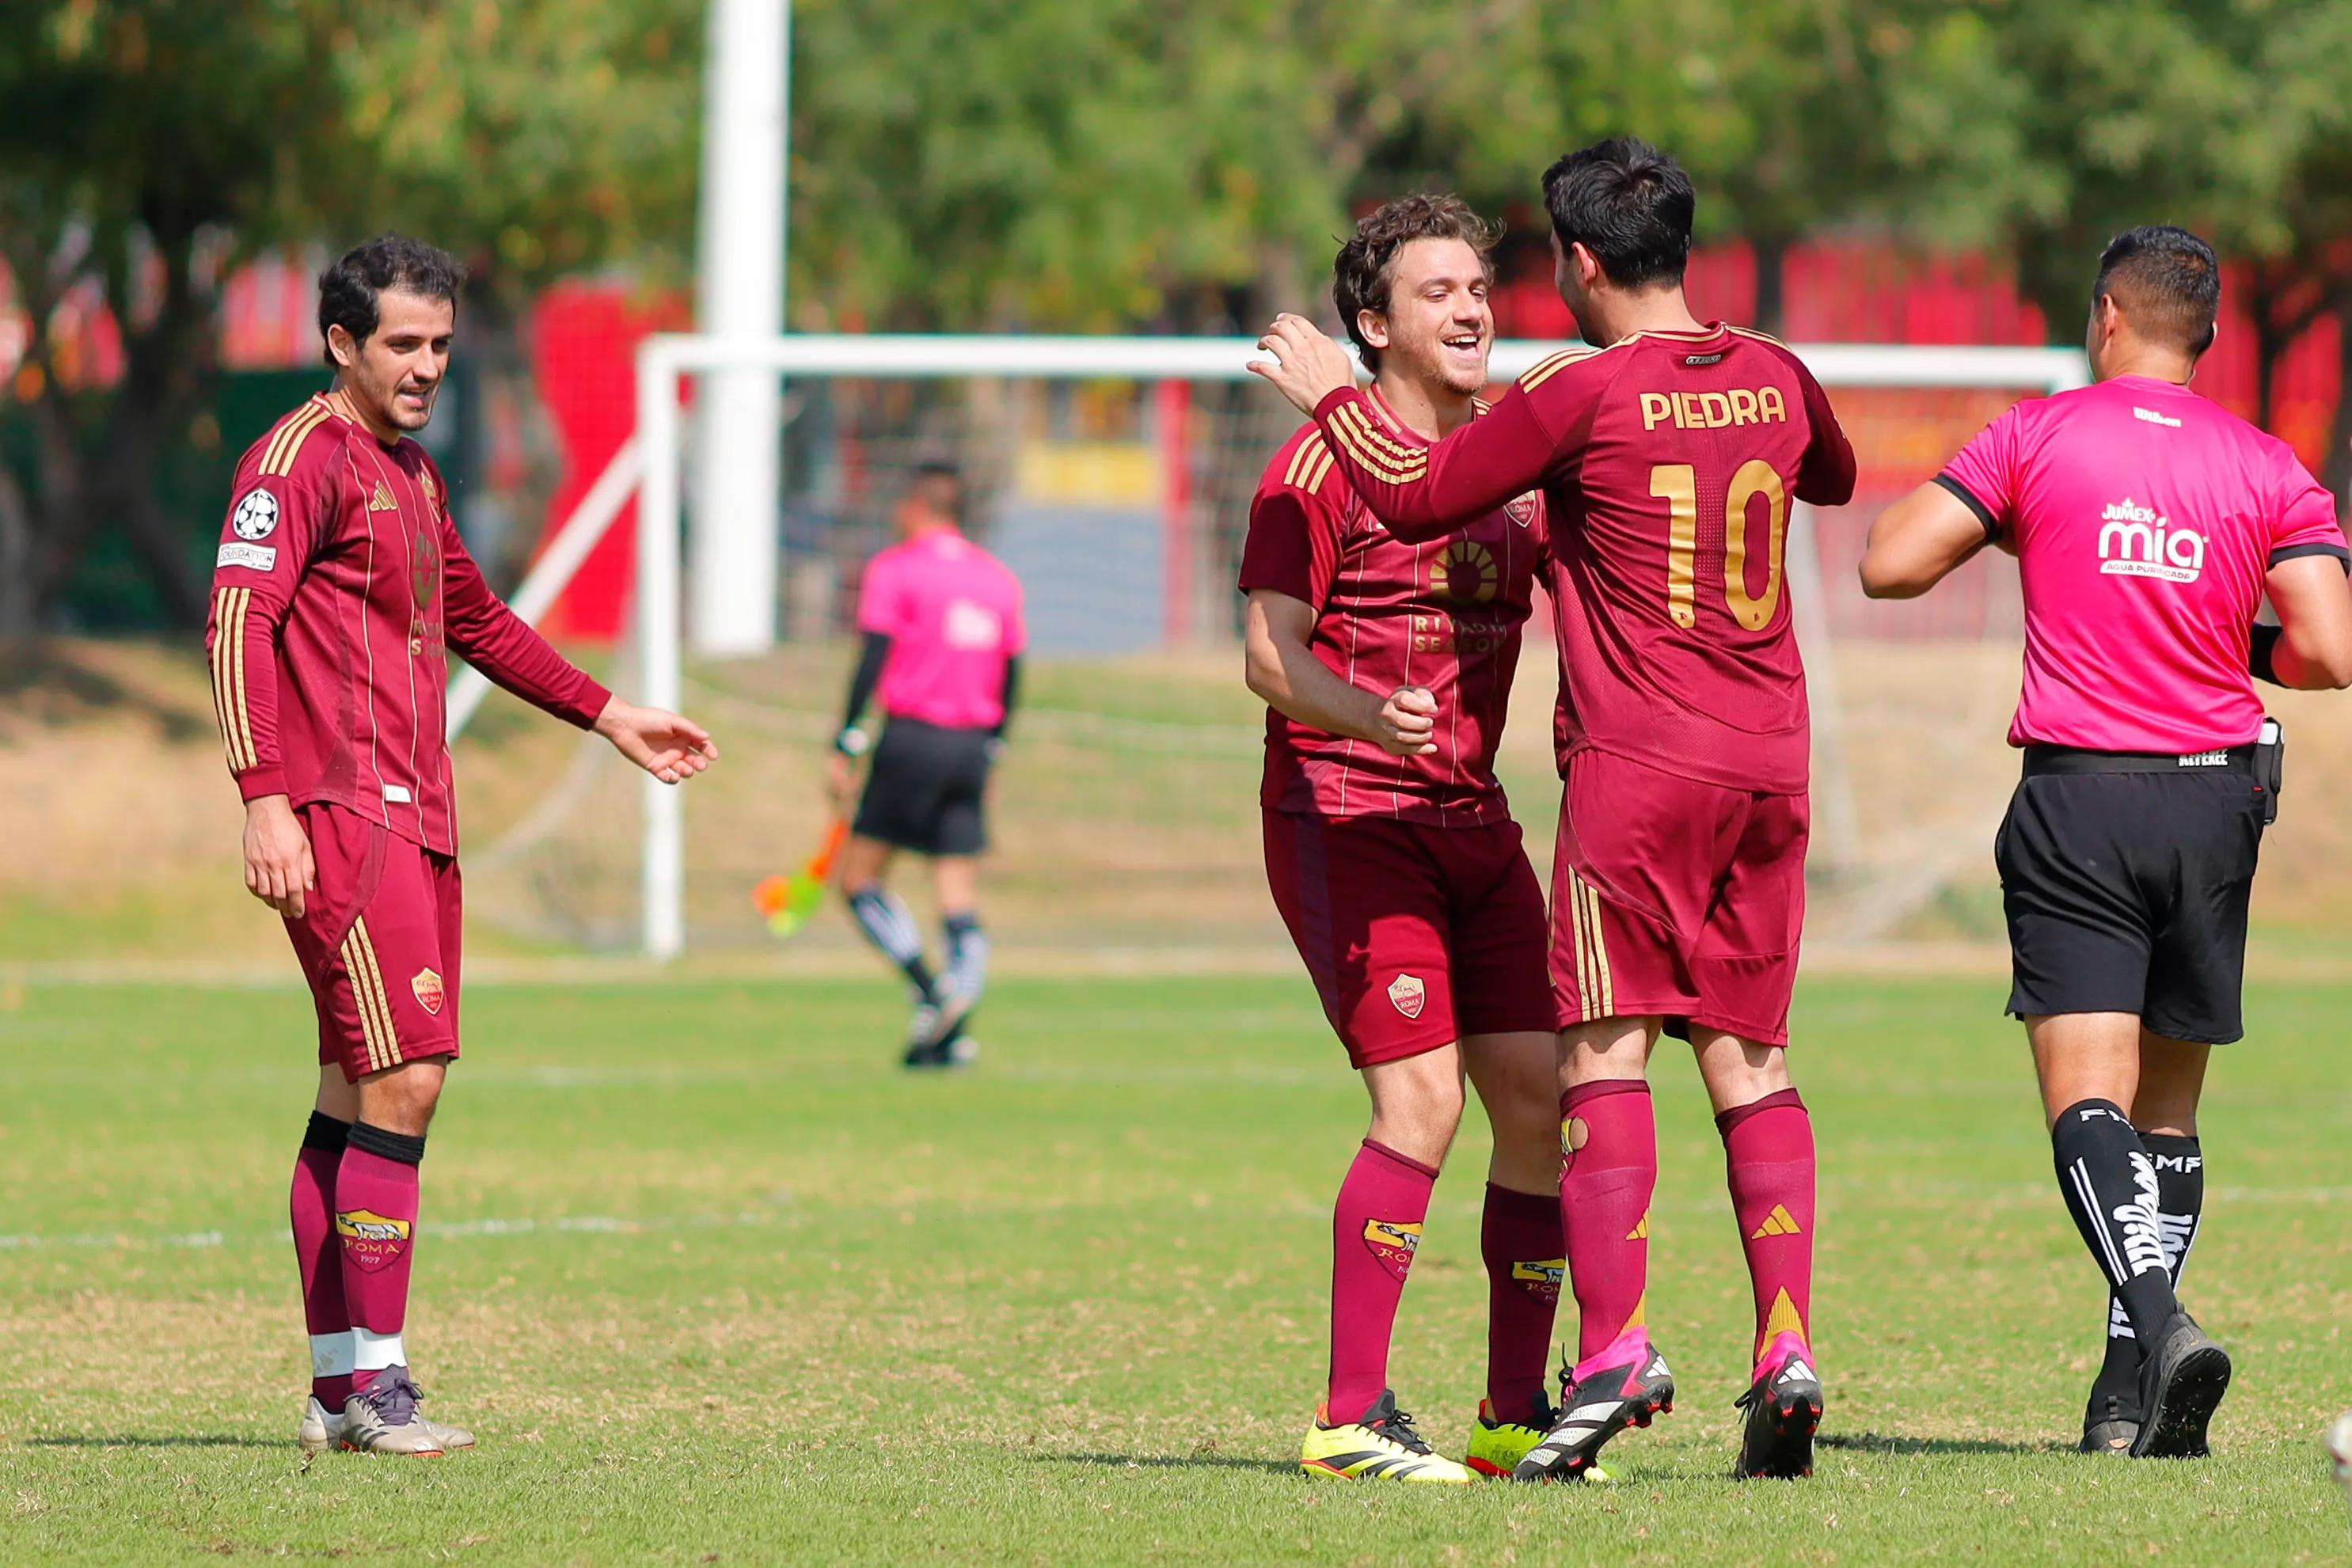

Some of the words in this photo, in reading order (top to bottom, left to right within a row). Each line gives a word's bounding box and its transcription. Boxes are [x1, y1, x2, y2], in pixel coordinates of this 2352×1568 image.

[1640, 386, 1787, 431] PIEDRA
[2133, 406, 2182, 428] Wilson
[2101, 503, 2153, 524] JUMEX
[1649, 459, 1785, 632] 10
[2098, 517, 2204, 570] mía
[344, 1239, 400, 1255] ROMA
[360, 1255, 380, 1265] 1927
